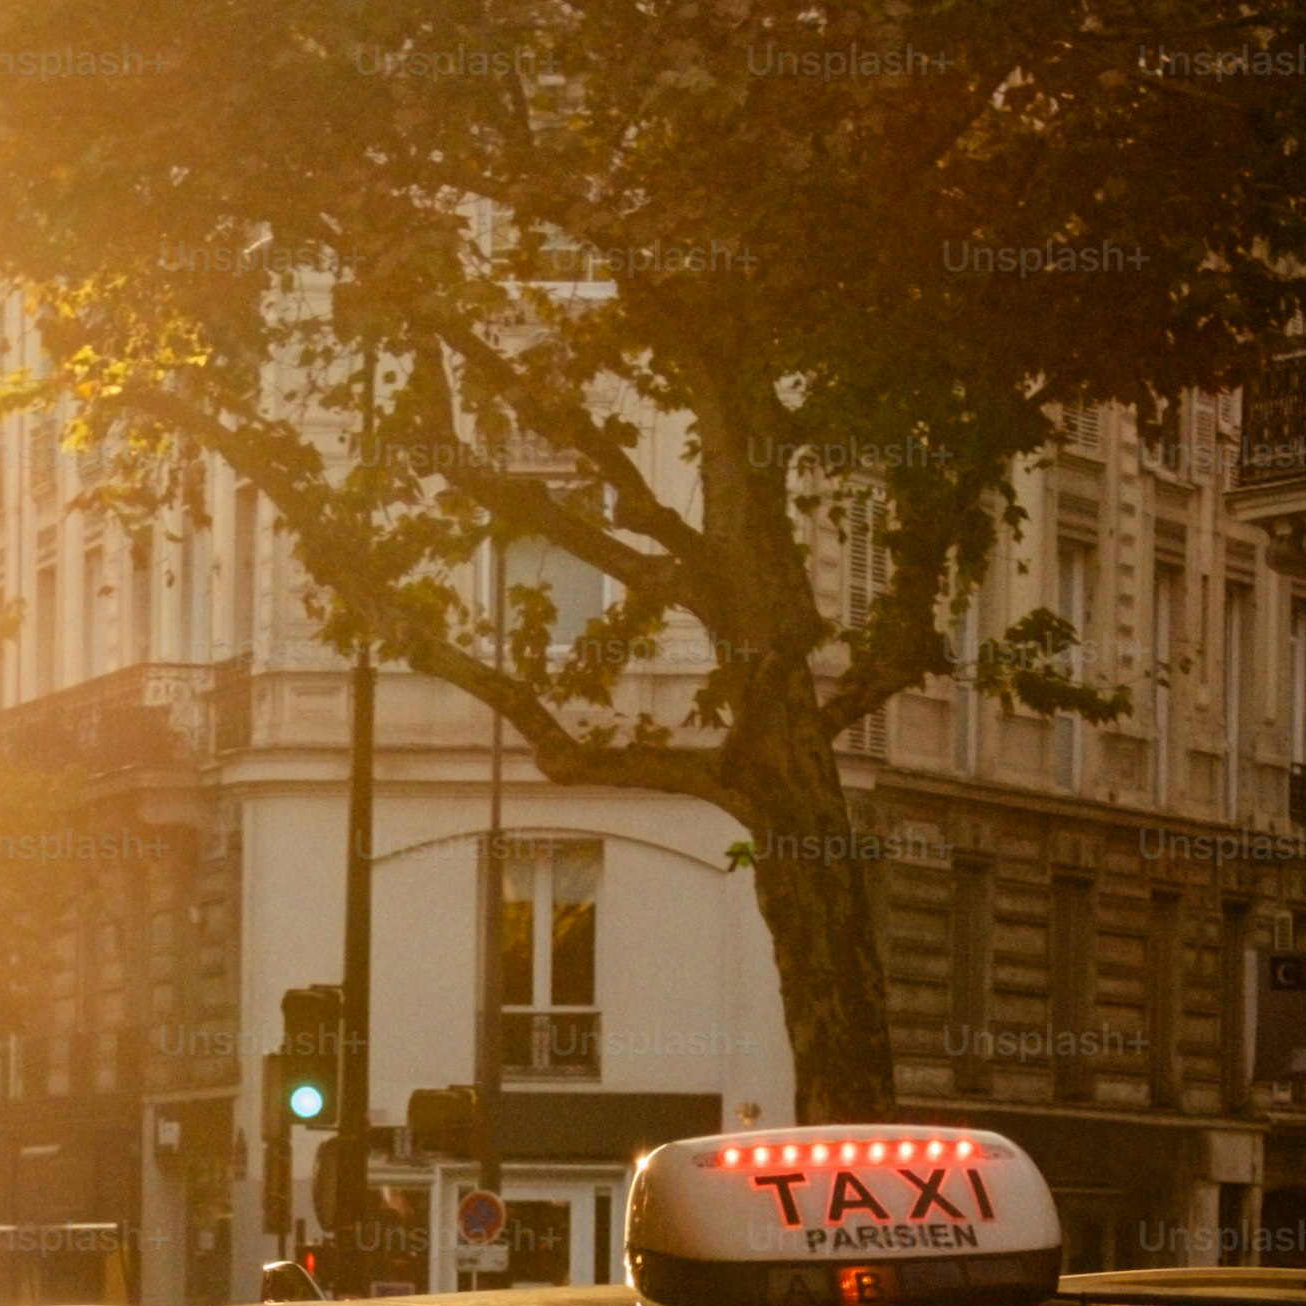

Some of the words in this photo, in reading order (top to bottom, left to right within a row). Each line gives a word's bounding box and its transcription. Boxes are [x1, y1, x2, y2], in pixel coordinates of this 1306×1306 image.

[754, 1168, 995, 1226] TAXI
[806, 1224, 979, 1253] PARISIEN
[857, 1273, 882, 1303] B
